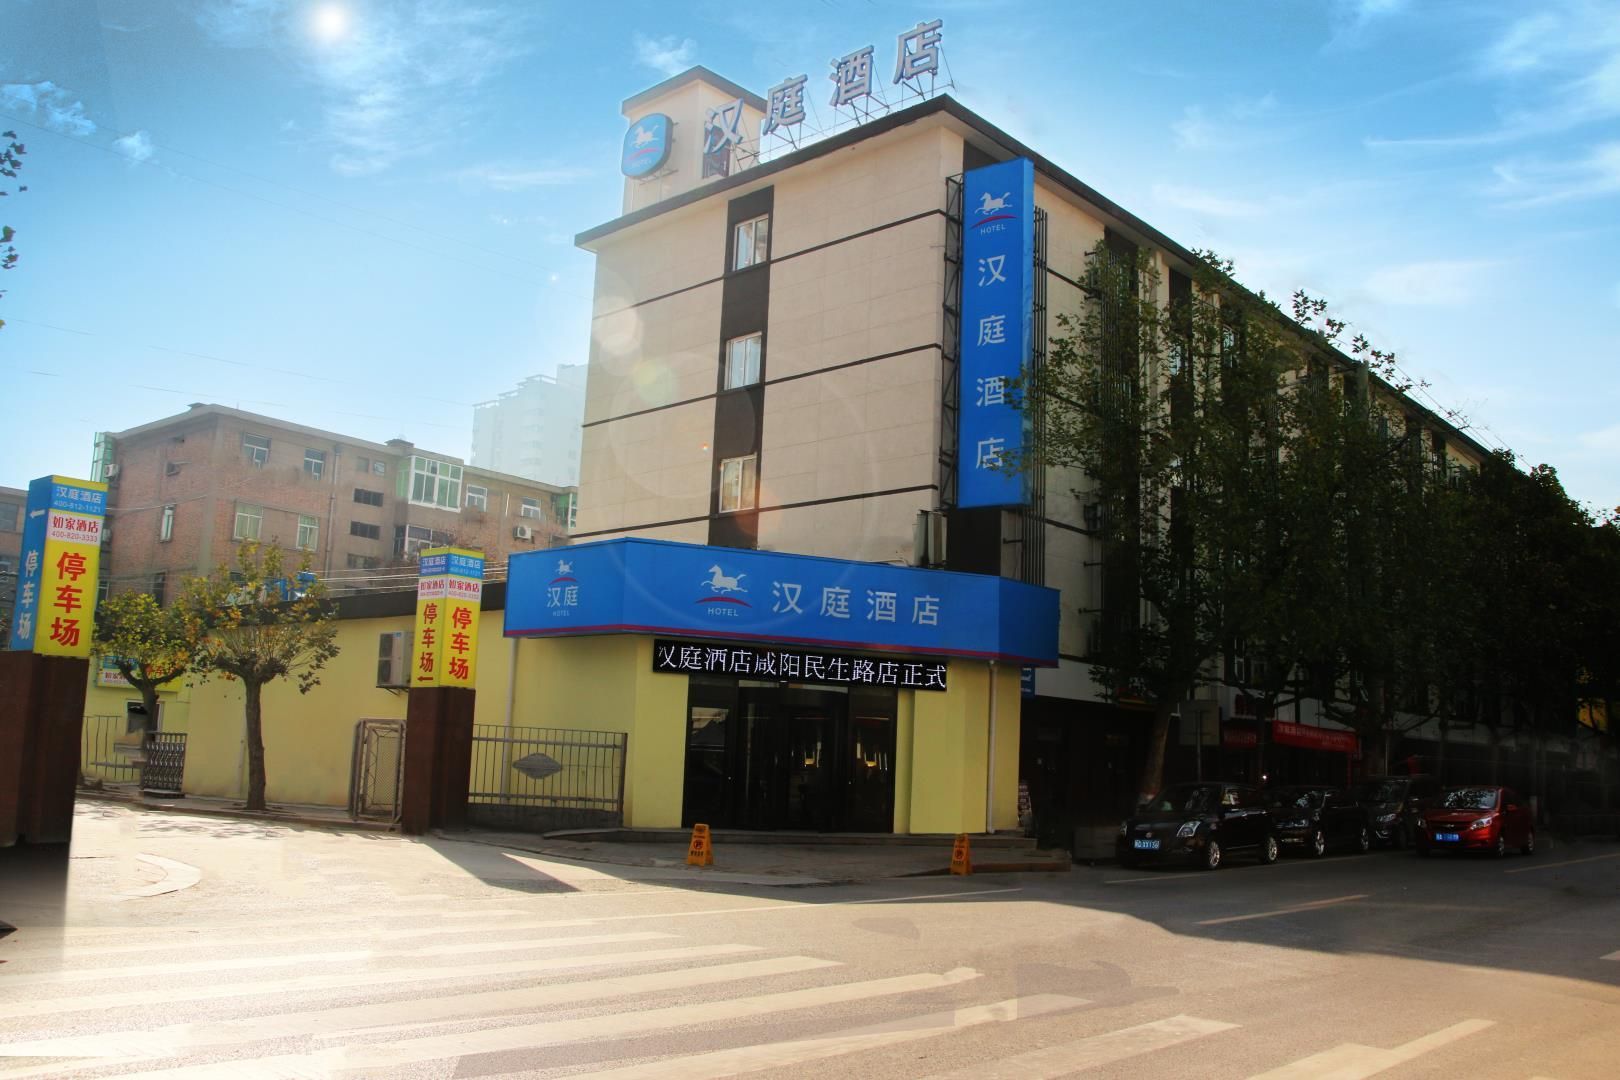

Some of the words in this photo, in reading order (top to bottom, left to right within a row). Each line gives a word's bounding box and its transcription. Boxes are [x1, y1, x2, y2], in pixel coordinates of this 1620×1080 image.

[703, 19, 943, 154] 汉庭酒店
[980, 224, 1006, 235] HOTEL
[976, 254, 1007, 470] 汉庭酒店
[56, 486, 103, 504] 汉庭酒店
[52, 531, 98, 542] 400-820-3333
[53, 515, 99, 533] 如家酒店
[17, 549, 39, 640] 停车场
[50, 552, 87, 647] 停车场
[547, 585, 579, 608] 汉庭
[707, 607, 739, 617] HOTEL
[772, 581, 941, 626] 汉庭酒店
[419, 603, 437, 673] 停车场
[449, 606, 472, 680] 停车场
